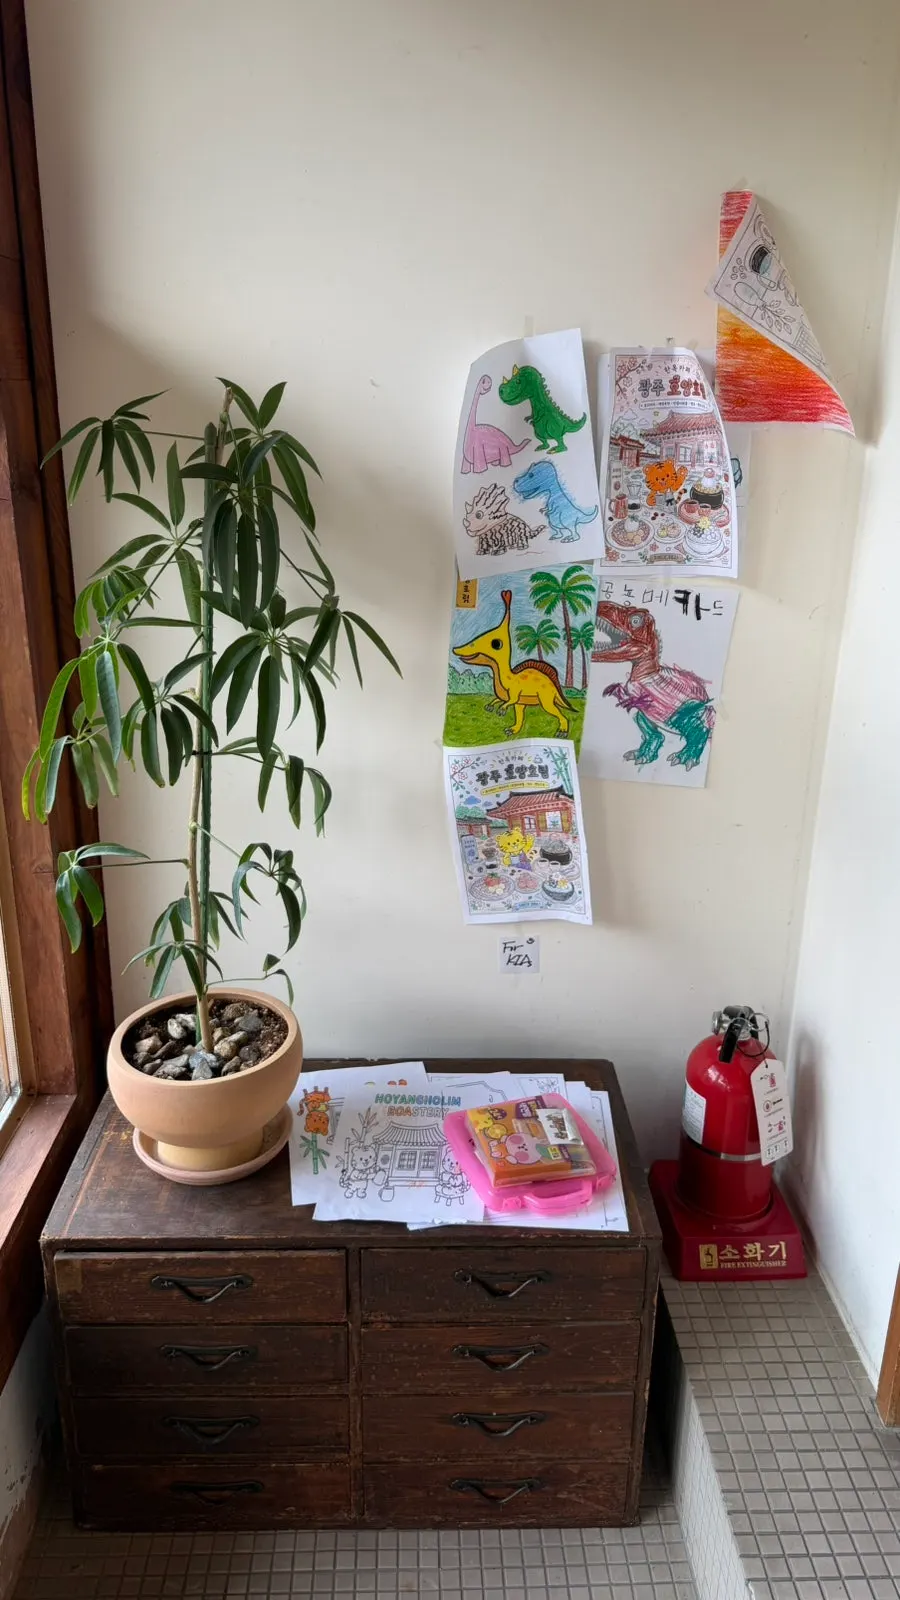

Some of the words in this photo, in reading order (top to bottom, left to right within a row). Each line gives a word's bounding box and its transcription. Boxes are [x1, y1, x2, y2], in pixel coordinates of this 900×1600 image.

[638, 378, 665, 398] 광주
[475, 769, 503, 787] 광주
[375, 1093, 462, 1107] HOYANGHOLIM
[719, 1241, 787, 1261] 소화기
[720, 1261, 737, 1269] FIRE
[737, 1260, 788, 1269] EXTINGUISHER
